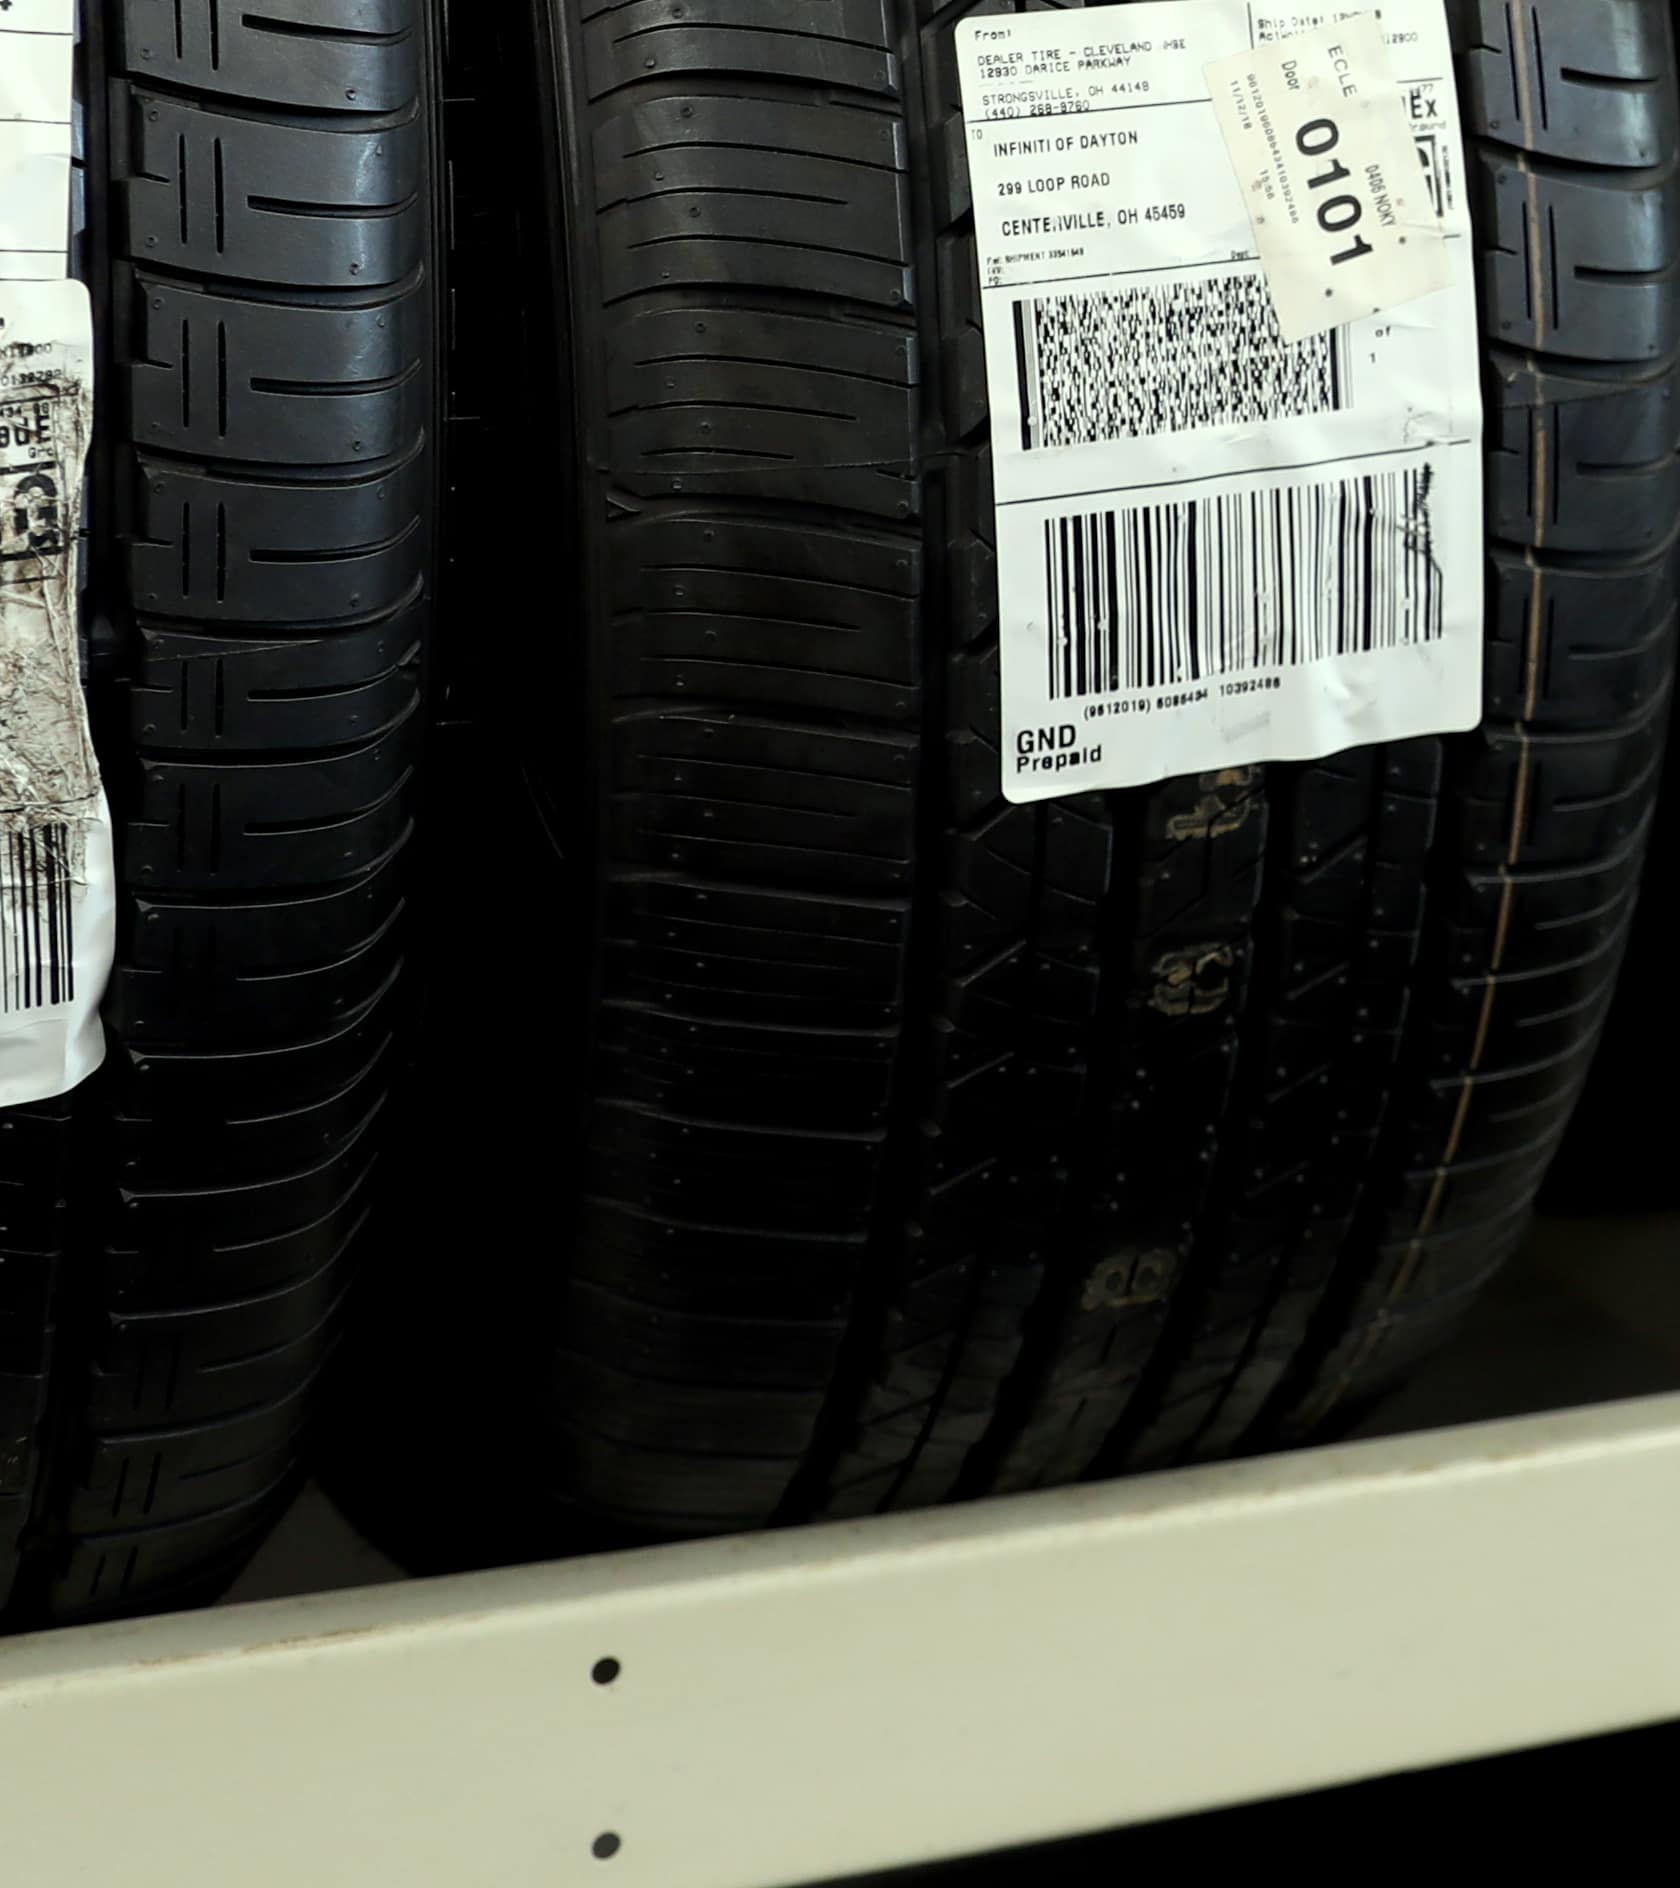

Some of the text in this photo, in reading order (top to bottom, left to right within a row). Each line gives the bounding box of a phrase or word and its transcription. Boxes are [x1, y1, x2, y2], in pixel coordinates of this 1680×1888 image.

[974, 28, 1012, 41] From:
[977, 40, 1153, 66] DEALER TIRE CLEVELAND
[1025, 55, 1133, 76] DARICE PARKWAY
[1280, 59, 1302, 92] Door
[1088, 86, 1104, 98] OH
[993, 130, 1139, 158] INFINITI OF DAYTON
[997, 172, 1111, 197] 299 LOOP ROAD
[1295, 118, 1374, 267] 0101
[1117, 202, 1186, 226] OH 45459
[1375, 325, 1391, 338] of
[1083, 698, 1151, 721] (9612019)
[1016, 724, 1077, 755] GND
[1016, 744, 1103, 774] Prepaid
